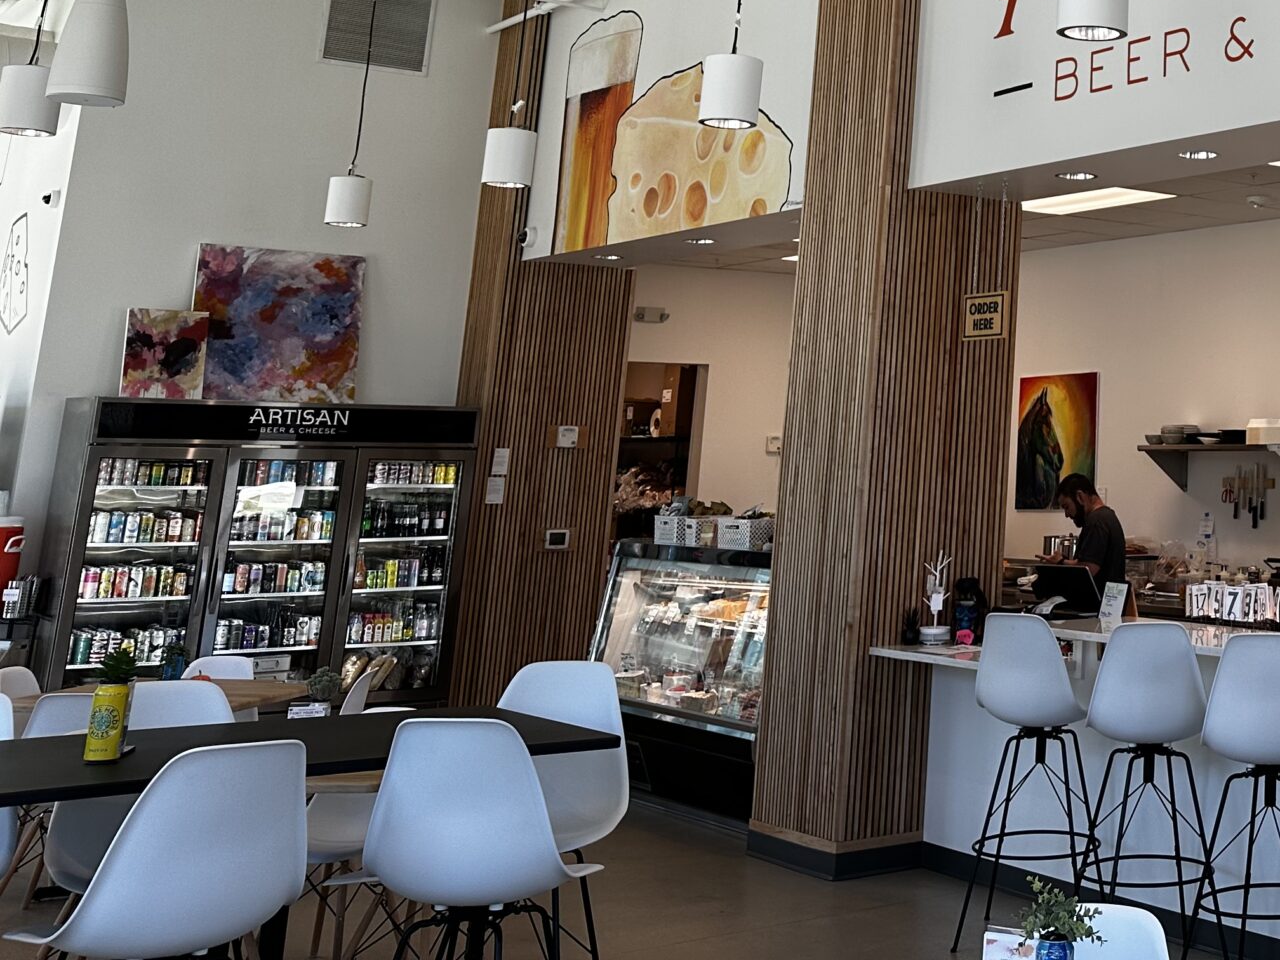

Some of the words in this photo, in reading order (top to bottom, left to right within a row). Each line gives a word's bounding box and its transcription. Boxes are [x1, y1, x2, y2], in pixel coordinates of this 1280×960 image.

[1054, 26, 1191, 102] BEER
[1224, 15, 1255, 64] &
[969, 301, 999, 316] ORDER
[972, 317, 994, 331] HERE
[248, 408, 350, 426] ARTISAN
[260, 426, 286, 434] BEER
[298, 427, 336, 435] CHEESE
[1194, 593, 1207, 609] 17
[1227, 591, 1239, 616] 7
